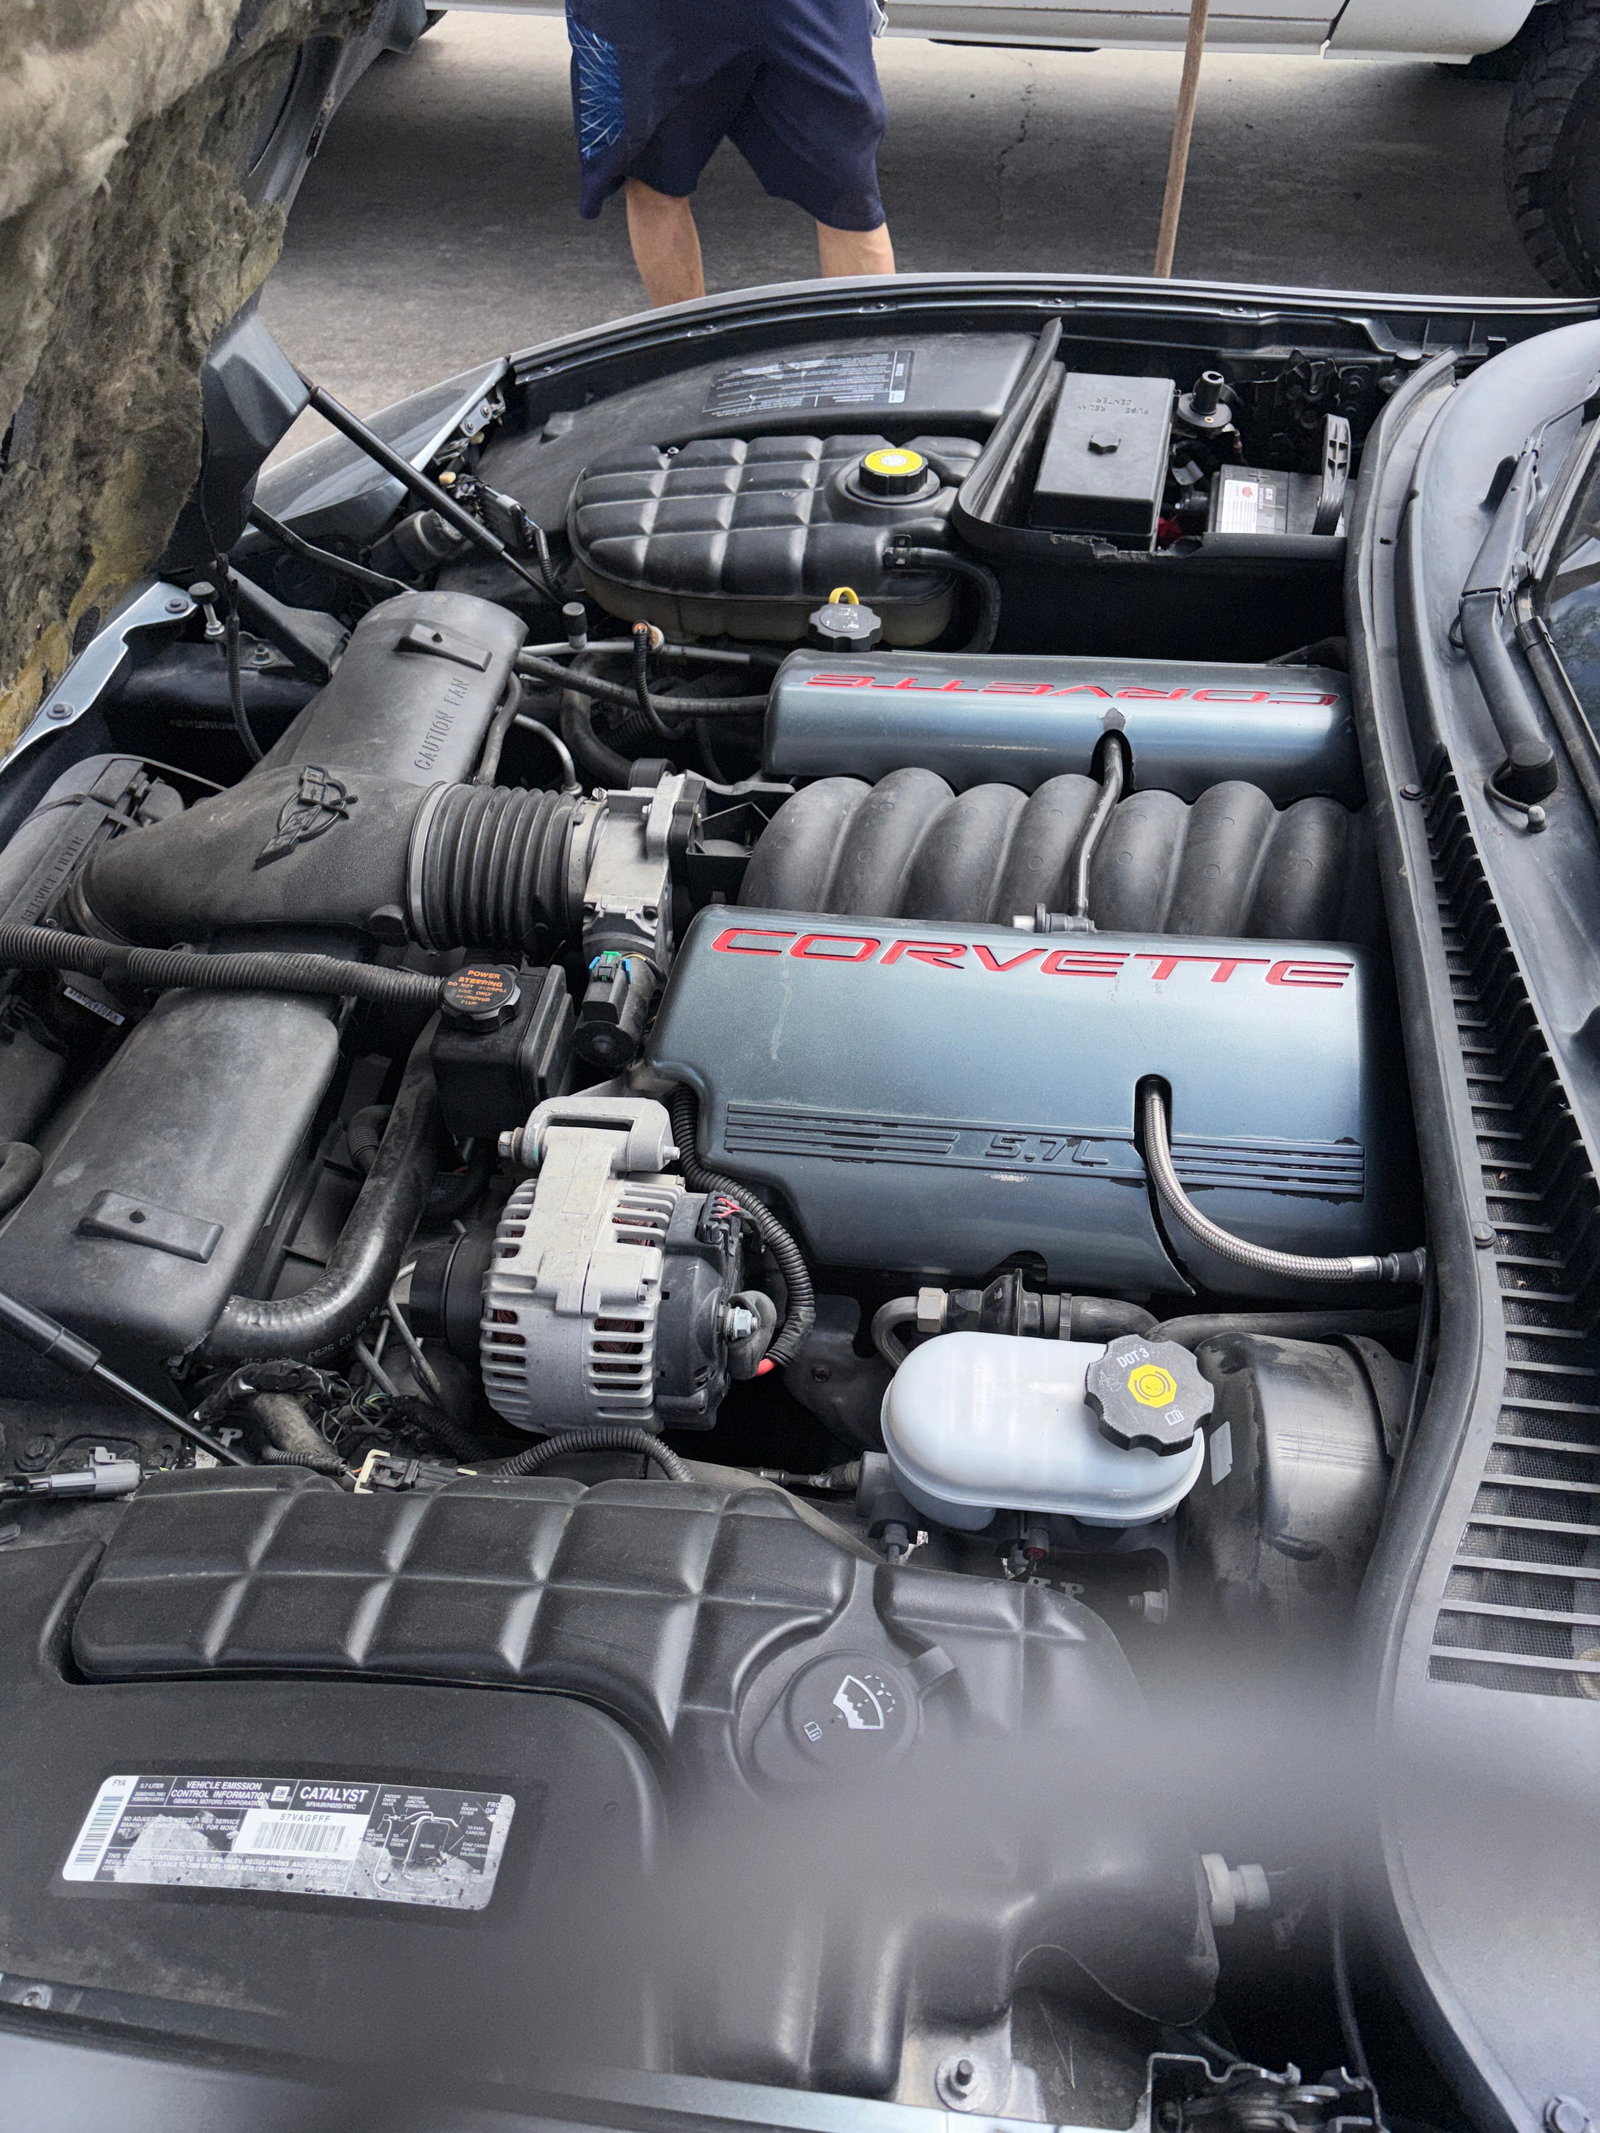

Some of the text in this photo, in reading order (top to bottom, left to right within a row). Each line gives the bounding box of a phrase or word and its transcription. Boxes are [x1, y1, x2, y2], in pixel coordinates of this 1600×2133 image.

[803, 674, 1341, 706] CORVETTE
[414, 677, 471, 770] CAUTION FAN
[711, 927, 1354, 989] CORVETTE
[467, 970, 501, 979] POWER
[458, 977, 503, 987] STEERING
[985, 1134, 1109, 1165] 5.7L
[1116, 1347, 1150, 1368] DOT 3
[112, 1779, 126, 1787] FYA
[186, 1781, 262, 1791] VEHICLE EMISSION
[171, 1789, 209, 1798] CONTROL
[212, 1791, 270, 1800] INFORMATION
[300, 1786, 369, 1802] CATALYST
[245, 1858, 289, 1866] REGULATIONS
